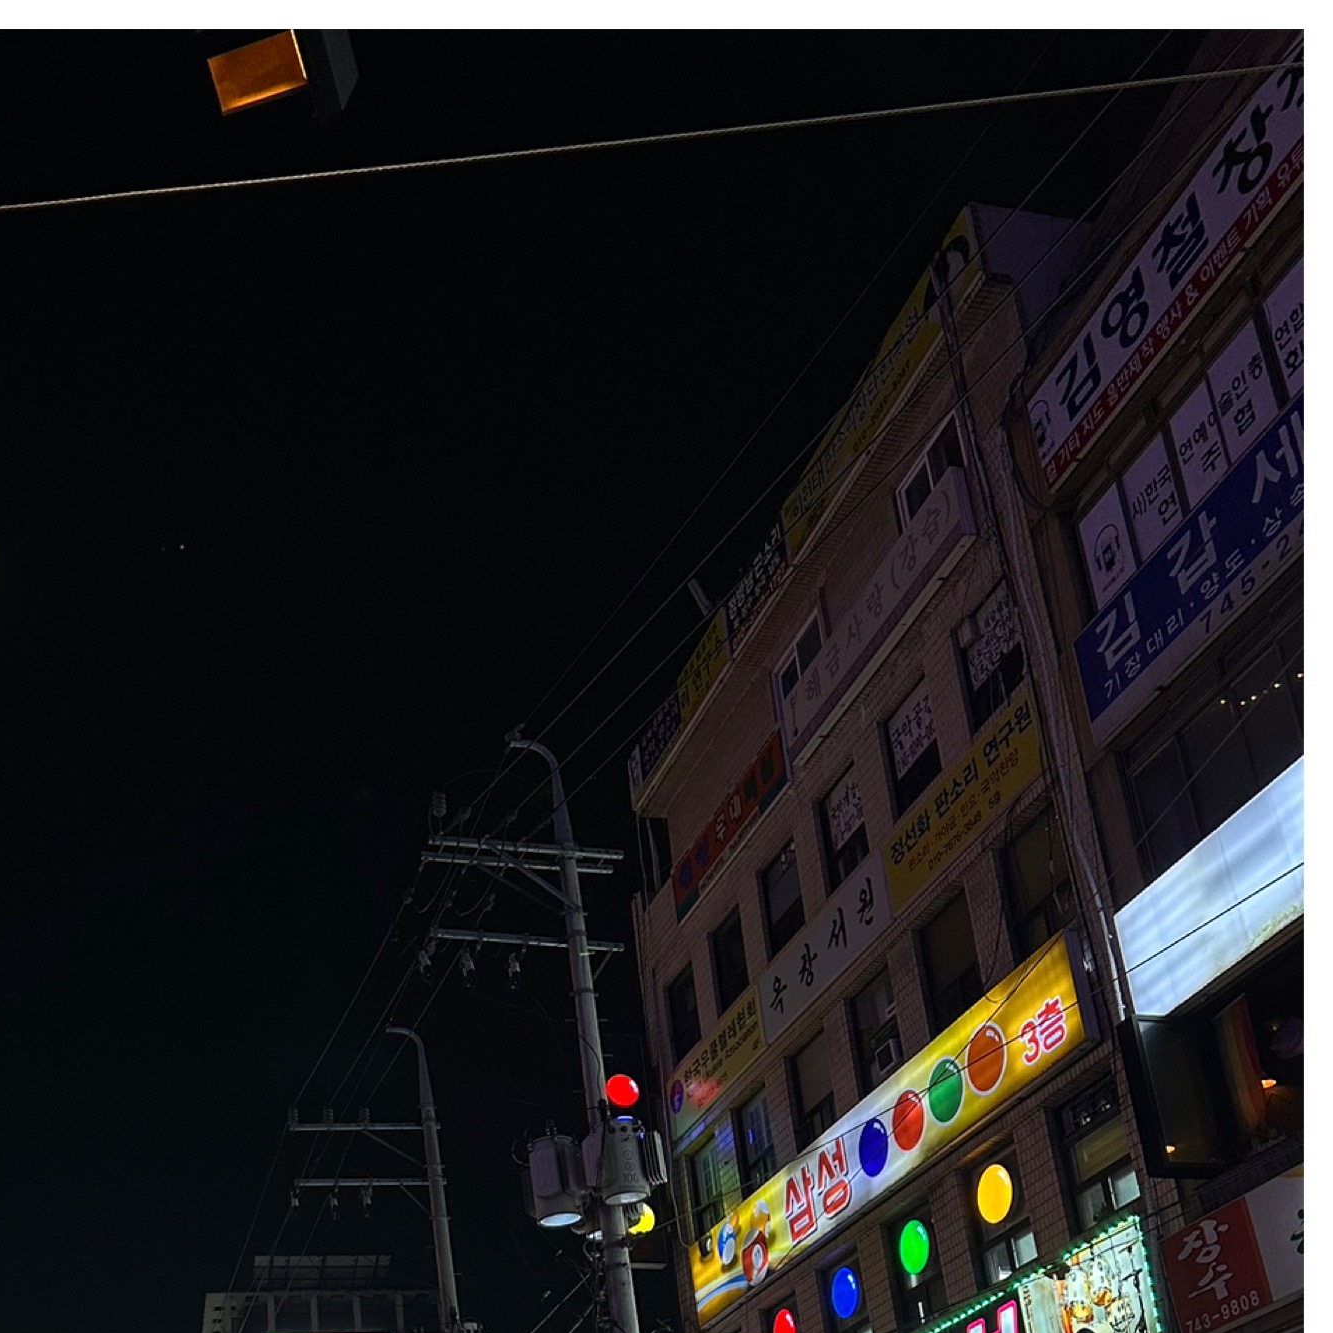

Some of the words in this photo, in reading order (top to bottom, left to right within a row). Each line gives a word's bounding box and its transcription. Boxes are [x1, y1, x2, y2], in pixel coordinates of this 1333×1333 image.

[1055, 192, 1210, 422] 김영철
[1107, 337, 1154, 404] 음반제작
[890, 808, 931, 865] 정선화
[934, 757, 979, 818] 판소리
[983, 700, 1033, 765] 연구원
[1020, 995, 1070, 1066] 3층
[785, 1138, 853, 1245] 삼성
[1178, 1219, 1234, 1301] 장수
